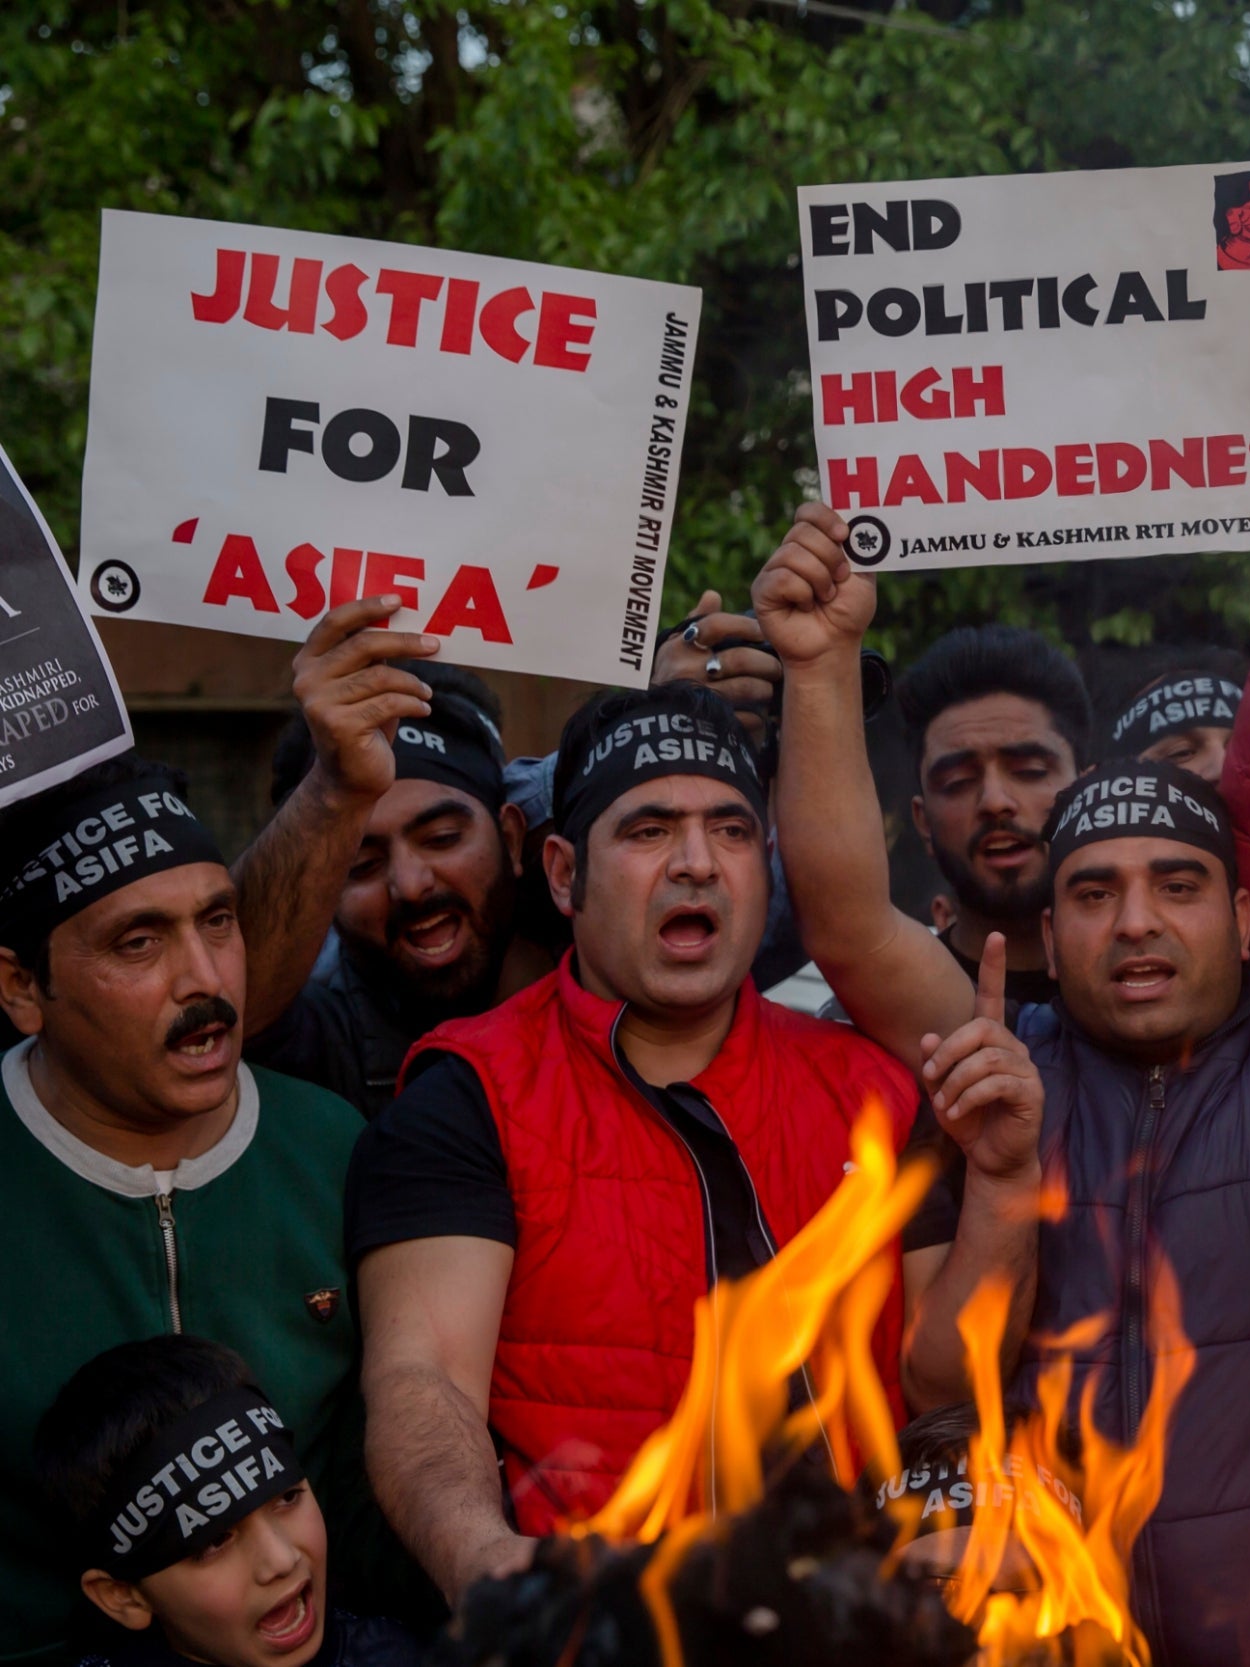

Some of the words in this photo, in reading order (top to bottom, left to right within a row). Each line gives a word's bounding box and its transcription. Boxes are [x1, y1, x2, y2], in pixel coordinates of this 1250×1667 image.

[809, 199, 961, 256] END
[190, 248, 597, 372] JUSTICE
[814, 268, 1207, 342] POLITICAL
[658, 312, 688, 389] JAMMU
[654, 394, 678, 409] &
[820, 365, 1006, 425] HIGH
[258, 397, 481, 497] FOR
[641, 414, 675, 510] KASHMIR
[636, 513, 662, 552] RTI
[899, 534, 986, 558] JAMMU
[993, 531, 1011, 549] &
[1016, 523, 1130, 549] KASHMIR
[1135, 521, 1177, 539] RTI
[172, 517, 559, 645] 'ASIFA'
[619, 555, 656, 671] MOVEMENT
[0, 670, 81, 712] KIDNAPPED,
[73, 694, 99, 715] FOR
[1112, 678, 1214, 741] JUSTICE
[1150, 699, 1233, 733] ASIFA
[398, 726, 447, 754] OR
[633, 738, 737, 774] ASIFA
[1051, 776, 1158, 841] JUSTICE
[1167, 783, 1220, 833] FOR
[1074, 802, 1175, 837] ASIFA
[54, 830, 174, 903] ASIFA
[110, 1418, 252, 1554] JUSTICE
[175, 1446, 285, 1538] ASIFA
